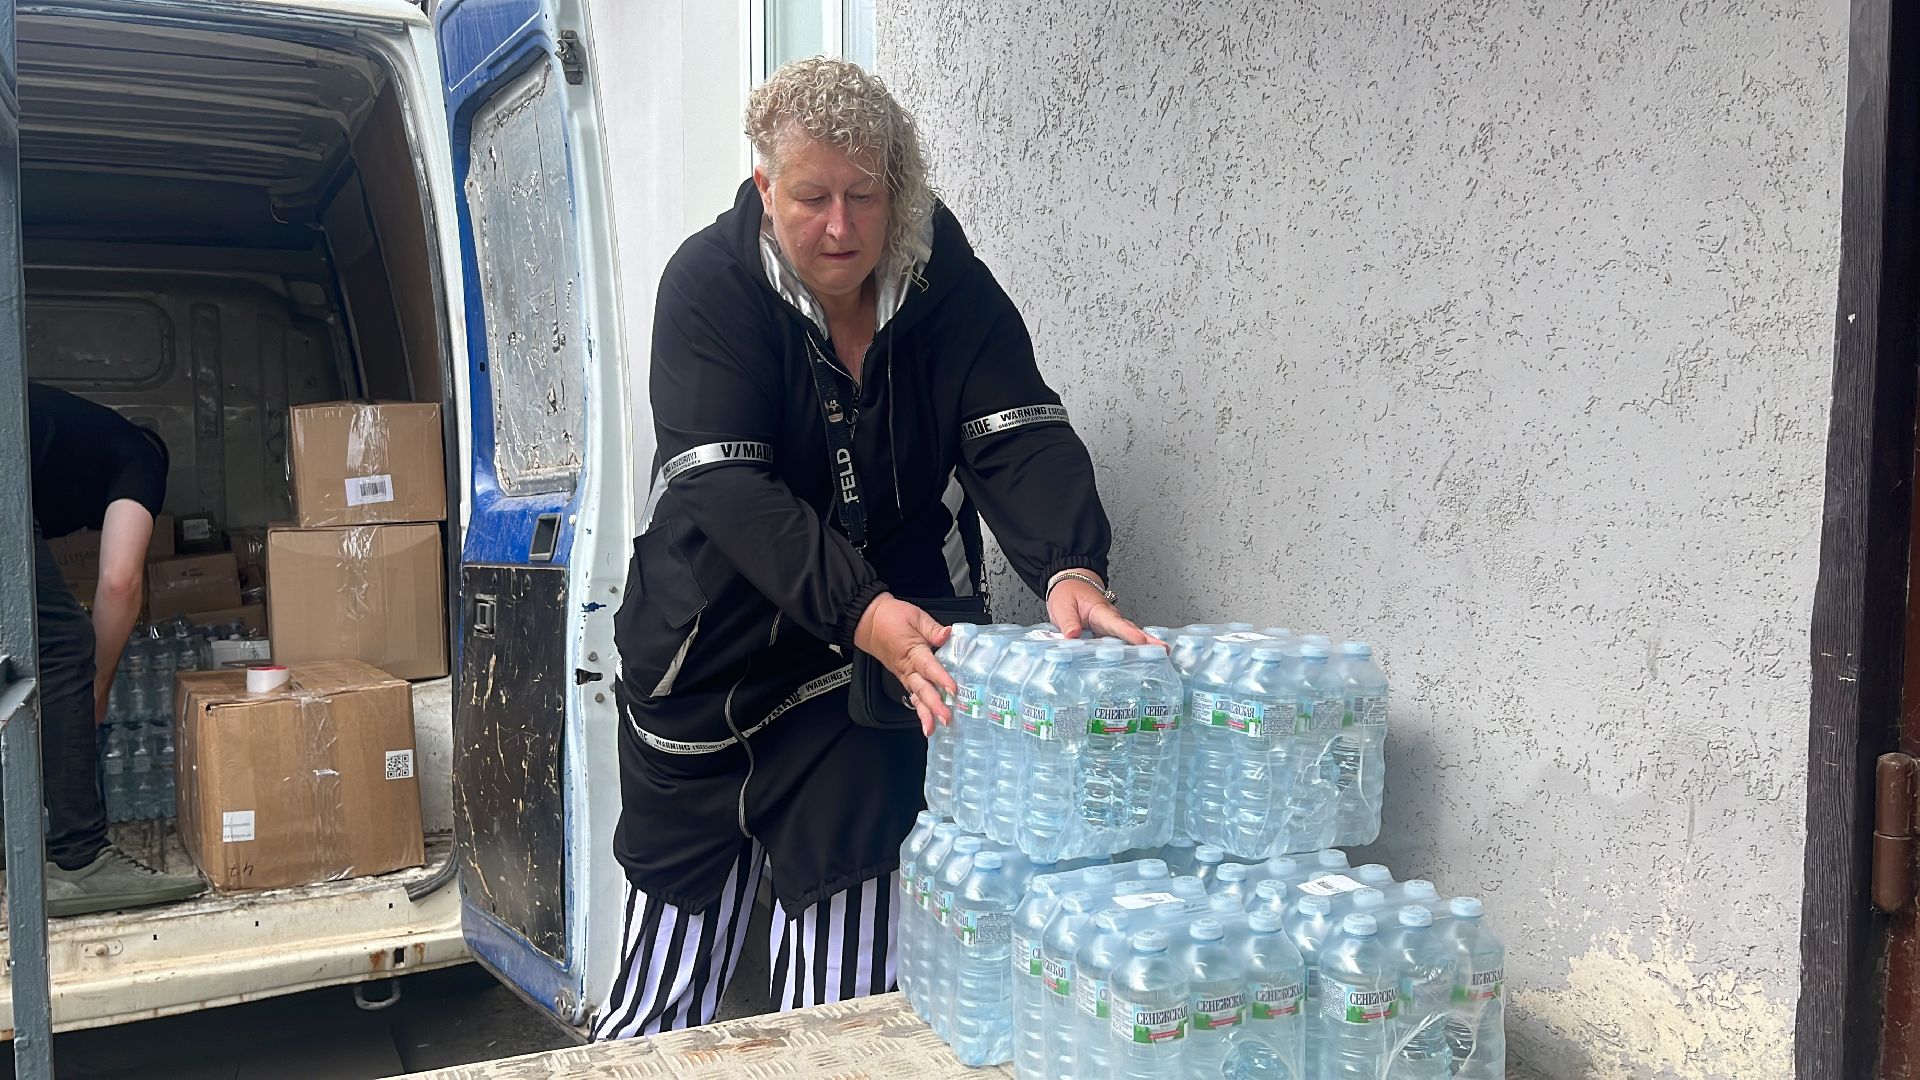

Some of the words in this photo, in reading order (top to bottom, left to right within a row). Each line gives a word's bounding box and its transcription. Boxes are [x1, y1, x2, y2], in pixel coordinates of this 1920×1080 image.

[1000, 406, 1047, 422] WARNING
[836, 448, 860, 504] FELD
[805, 671, 842, 693] WARNING
[654, 738, 691, 751] WARNING
[1136, 1004, 1188, 1025] СЕНЕЖСКАЯ
